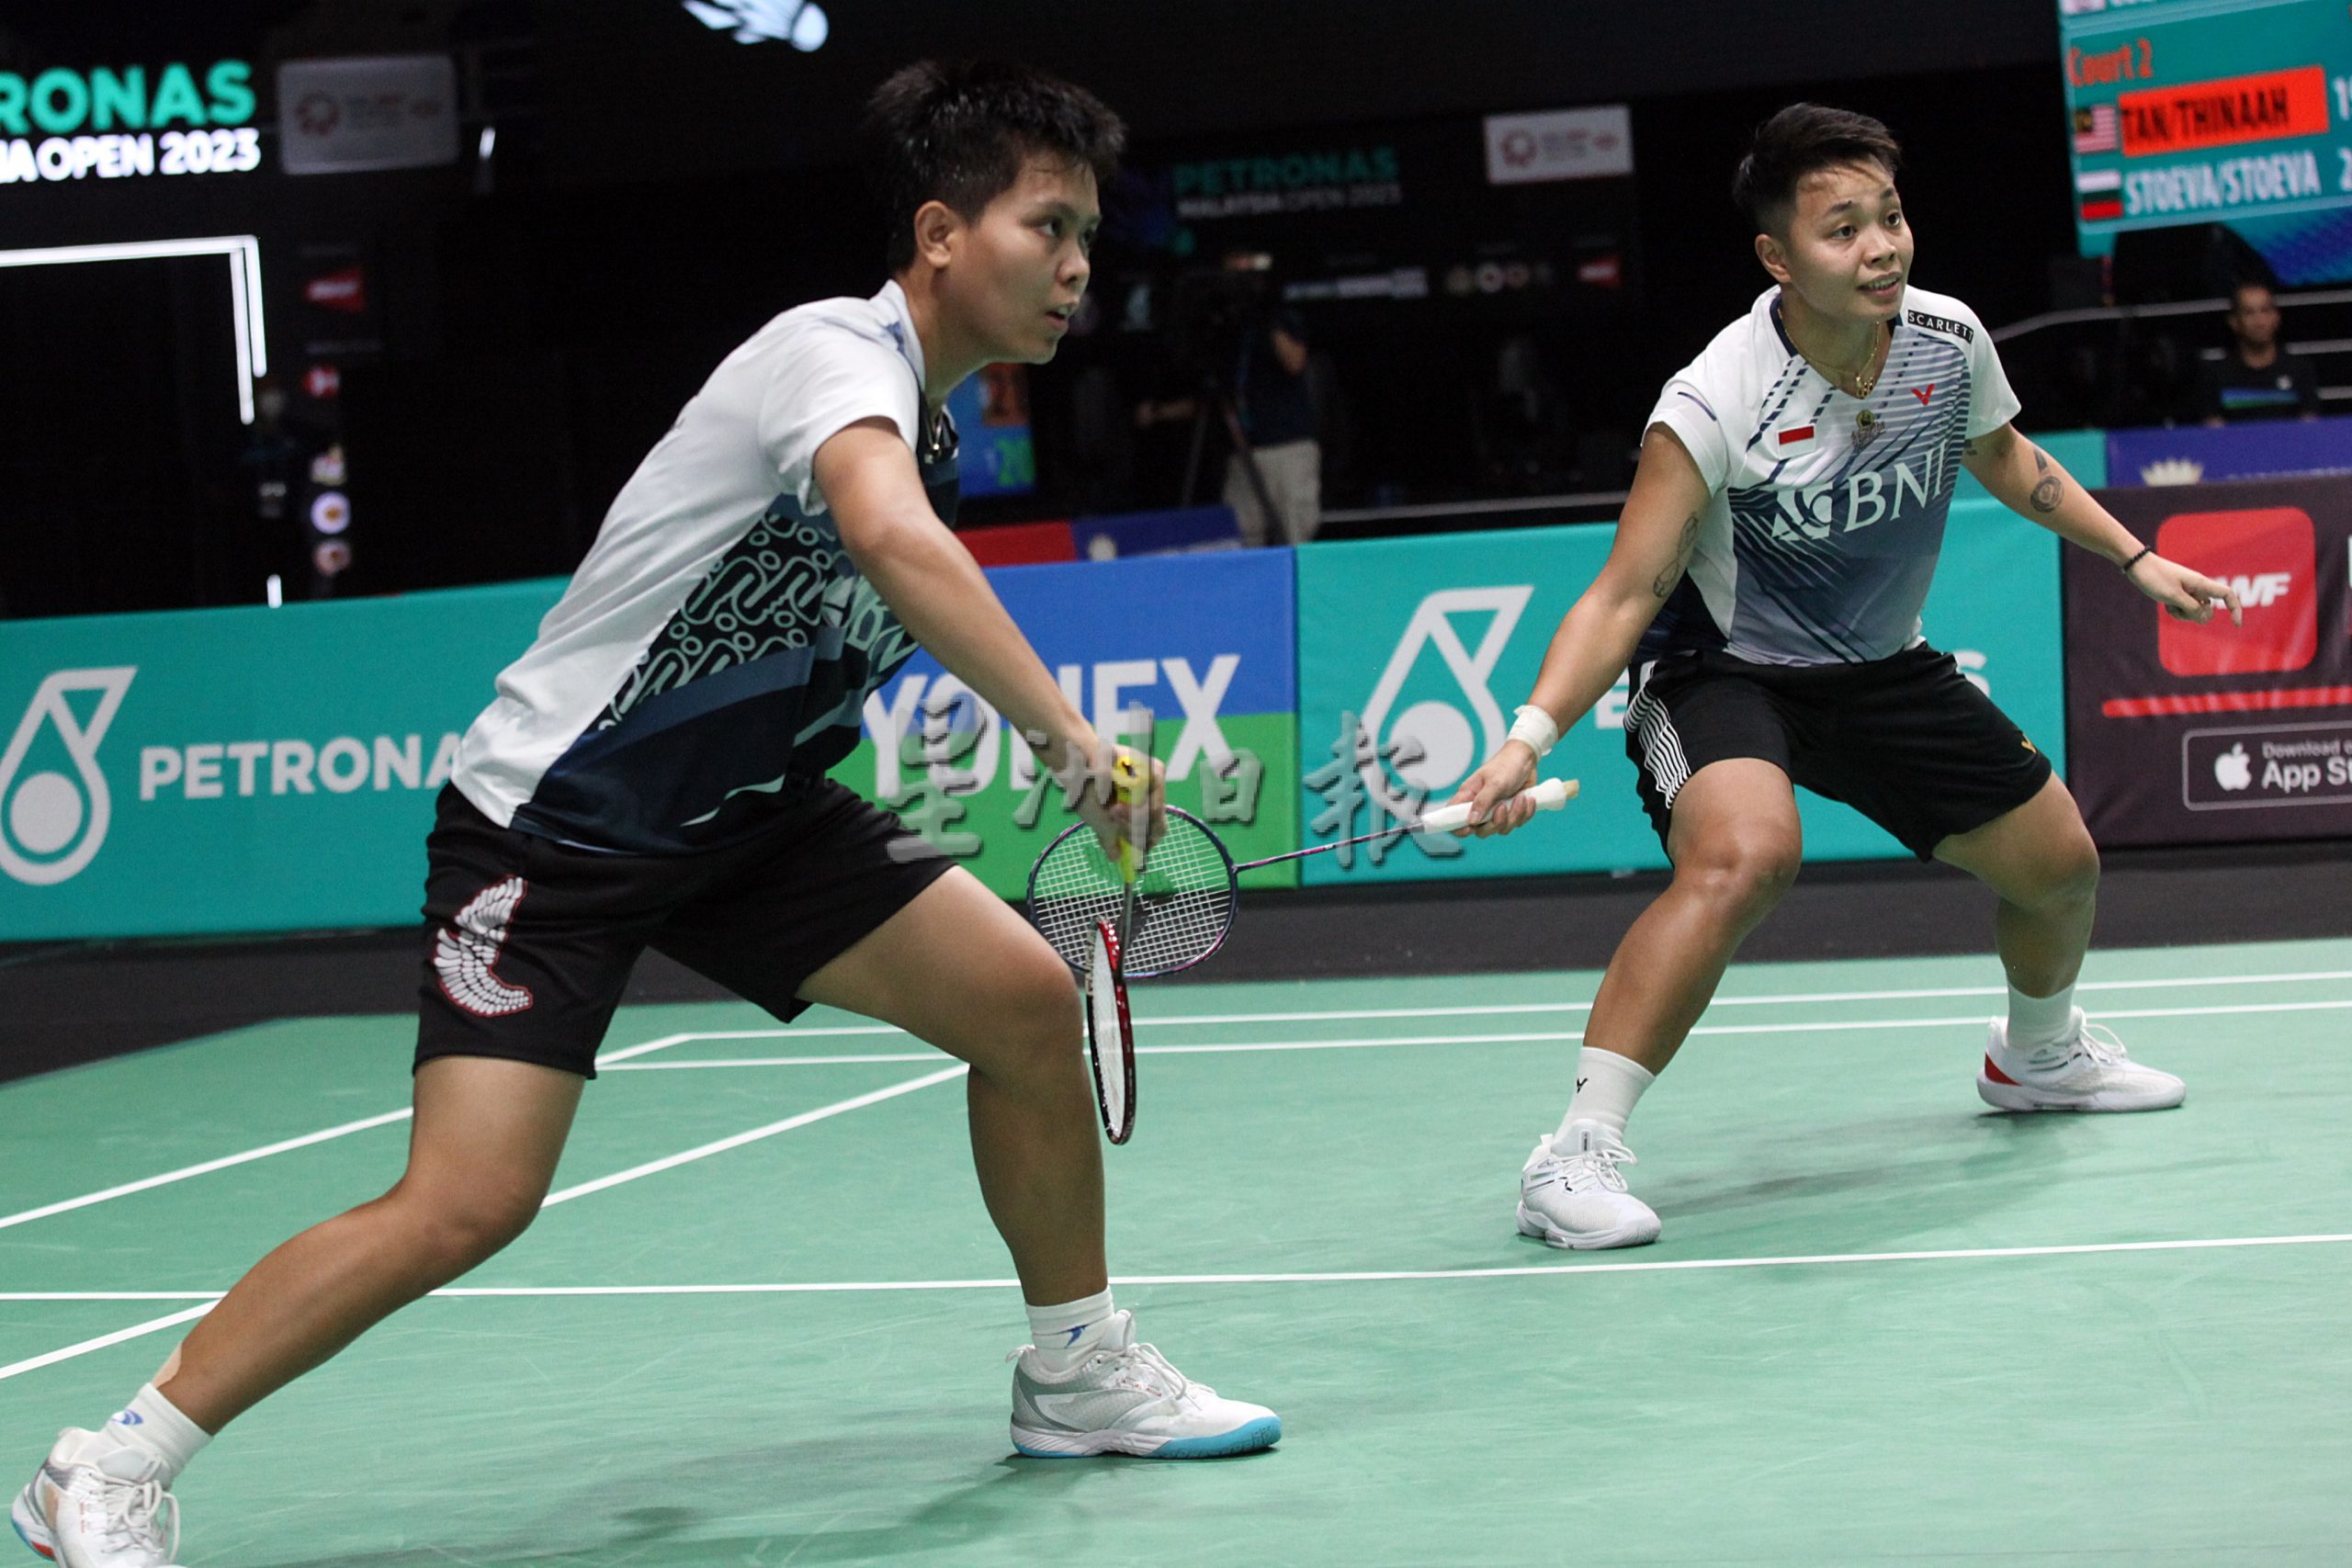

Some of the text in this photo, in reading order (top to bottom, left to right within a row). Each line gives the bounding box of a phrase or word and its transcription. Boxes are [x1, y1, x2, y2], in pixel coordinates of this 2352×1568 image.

[36, 132, 154, 181] OPEN
[158, 127, 262, 175] 2023
[1908, 311, 1973, 341] SCARLETT
[1844, 439, 1946, 533] BNI
[2262, 739, 2340, 760] Download
[2261, 759, 2321, 794] App
